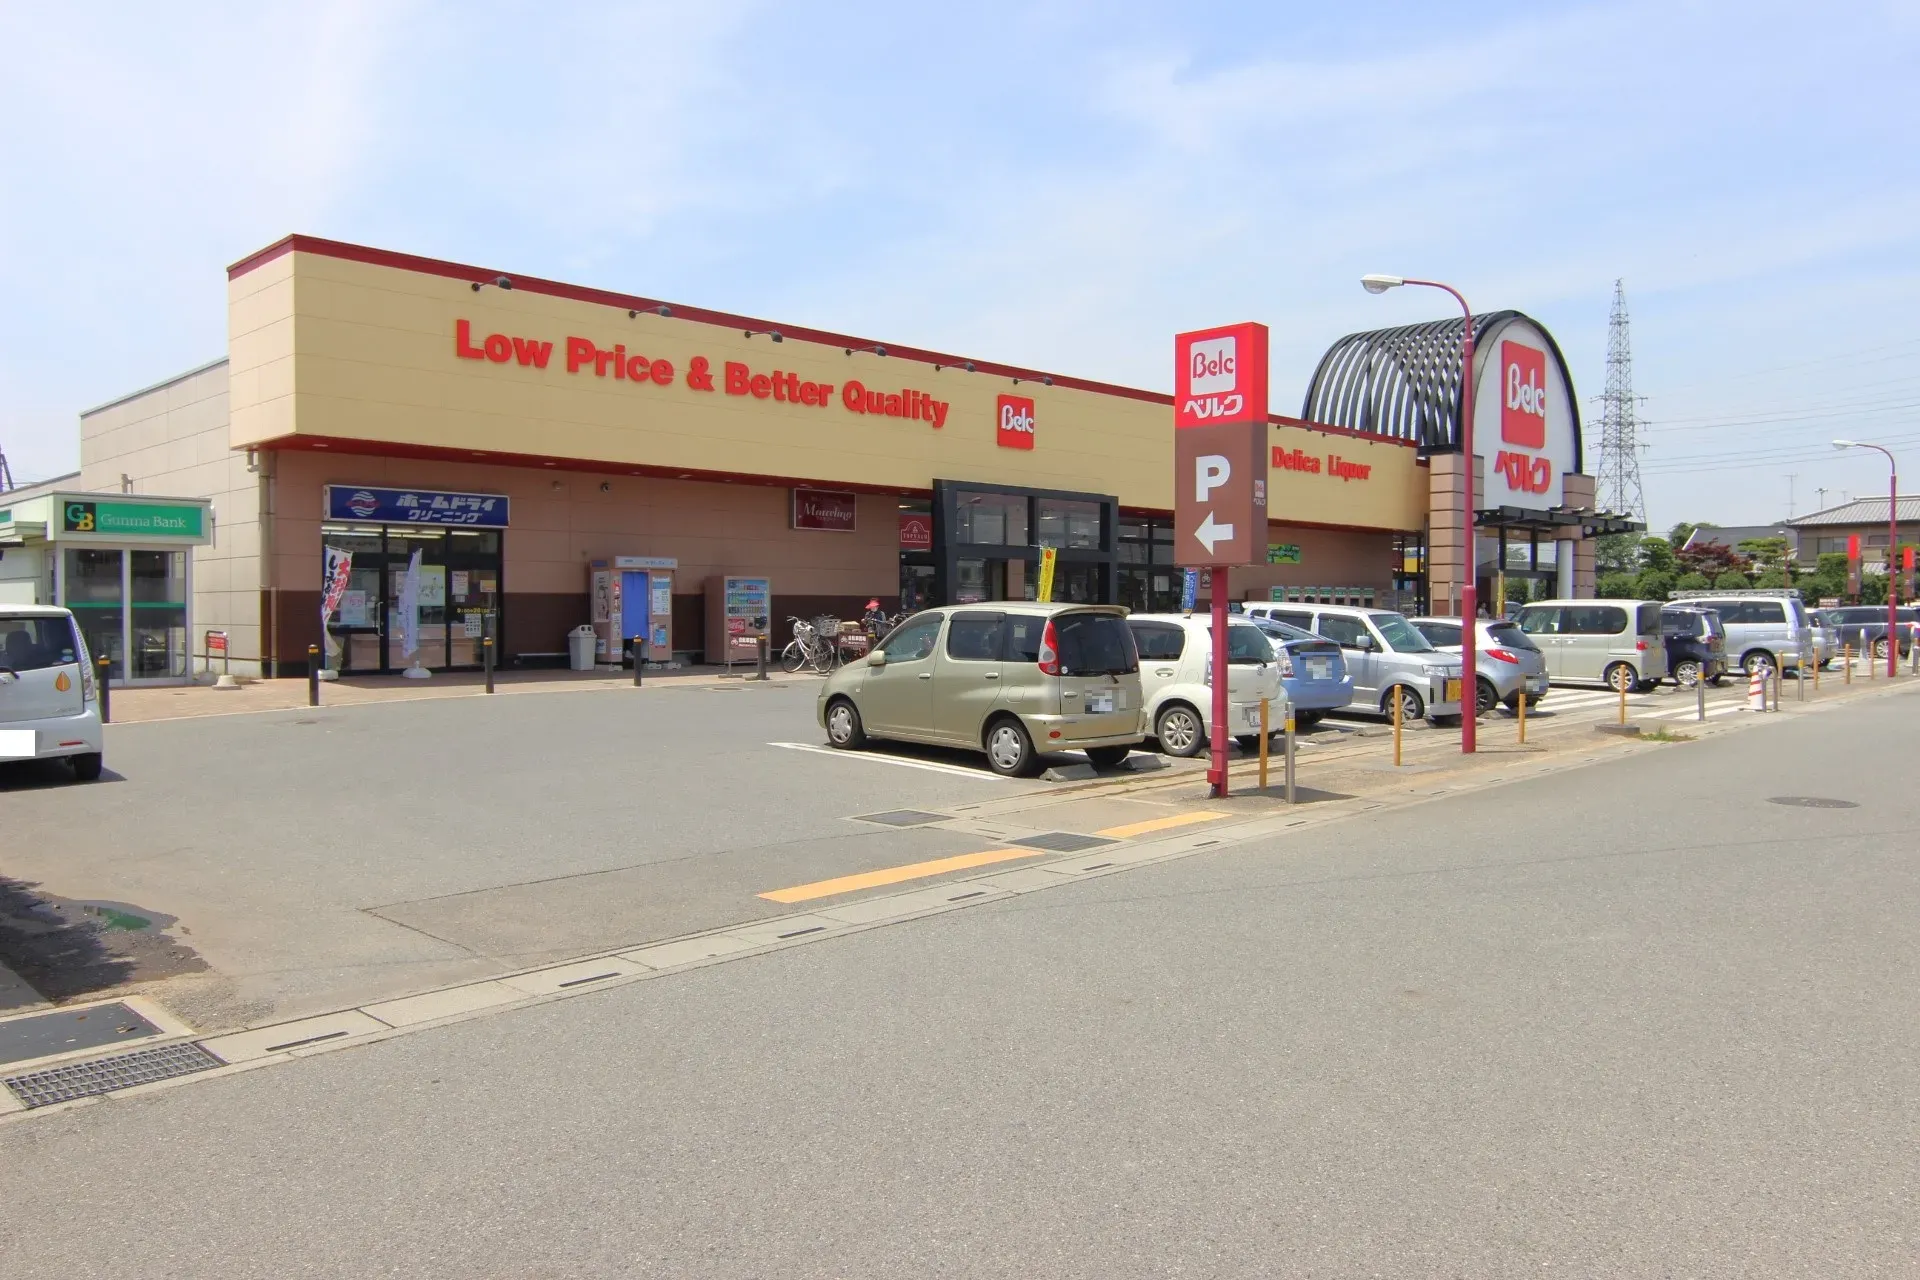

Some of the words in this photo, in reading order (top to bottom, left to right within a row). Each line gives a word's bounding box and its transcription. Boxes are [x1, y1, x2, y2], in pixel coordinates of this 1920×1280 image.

[455, 319, 554, 369] Low
[567, 335, 674, 387] Price
[686, 356, 715, 392] &
[725, 361, 835, 408] Better
[842, 379, 949, 429] Quality
[1192, 350, 1234, 379] Belc
[1507, 362, 1544, 418] Belc
[1001, 404, 1034, 434] Belc
[1183, 394, 1243, 419] ベルク
[1195, 454, 1231, 503] P
[1271, 446, 1321, 474] Delica
[1328, 455, 1372, 482] Liquor
[1494, 450, 1551, 494] ベルク
[396, 494, 496, 511] ホームドライ
[408, 509, 482, 523] クリーニング
[101, 513, 151, 528] Gunma
[153, 515, 186, 528] Bank
